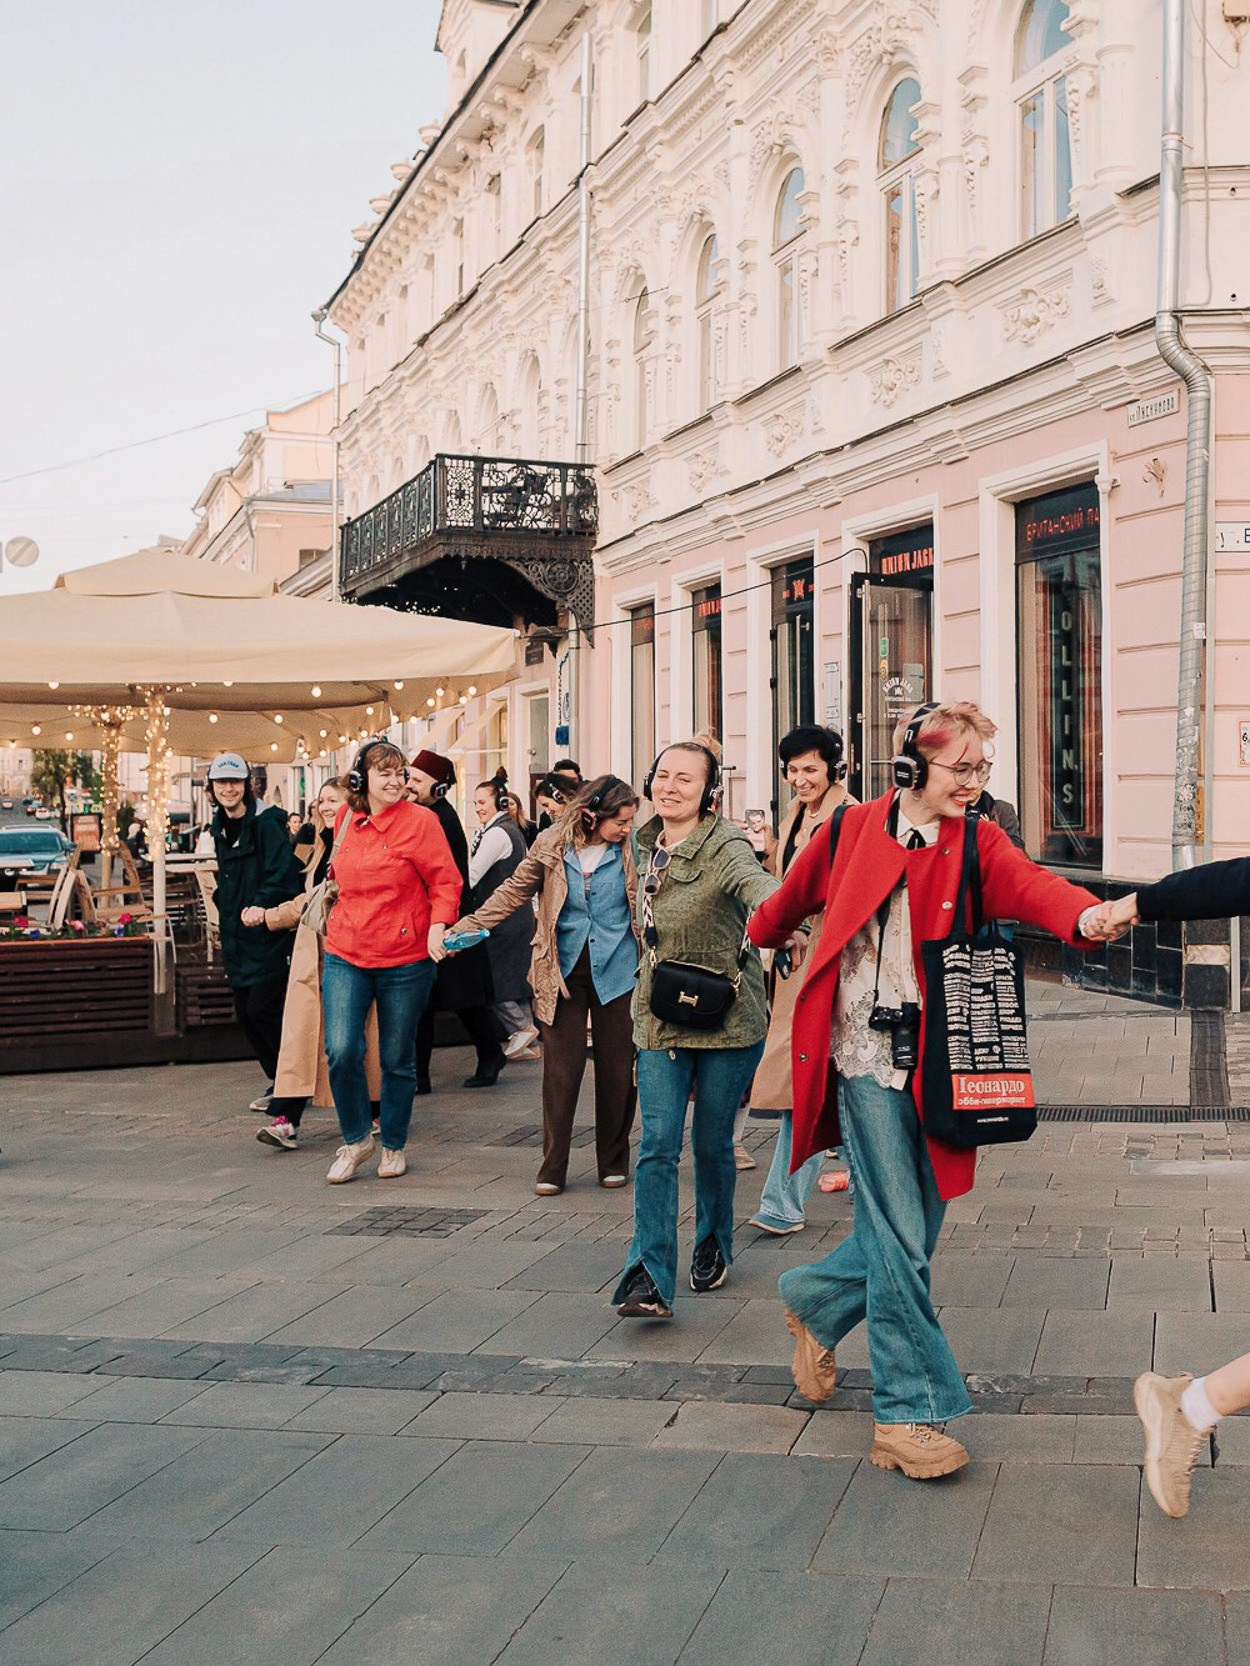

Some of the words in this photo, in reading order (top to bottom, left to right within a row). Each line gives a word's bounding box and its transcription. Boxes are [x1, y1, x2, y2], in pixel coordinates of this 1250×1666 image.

[1026, 507, 1083, 541] БРИТАНСКИЙ
[1087, 507, 1100, 526] ПА
[1061, 611, 1076, 804] OLLINS
